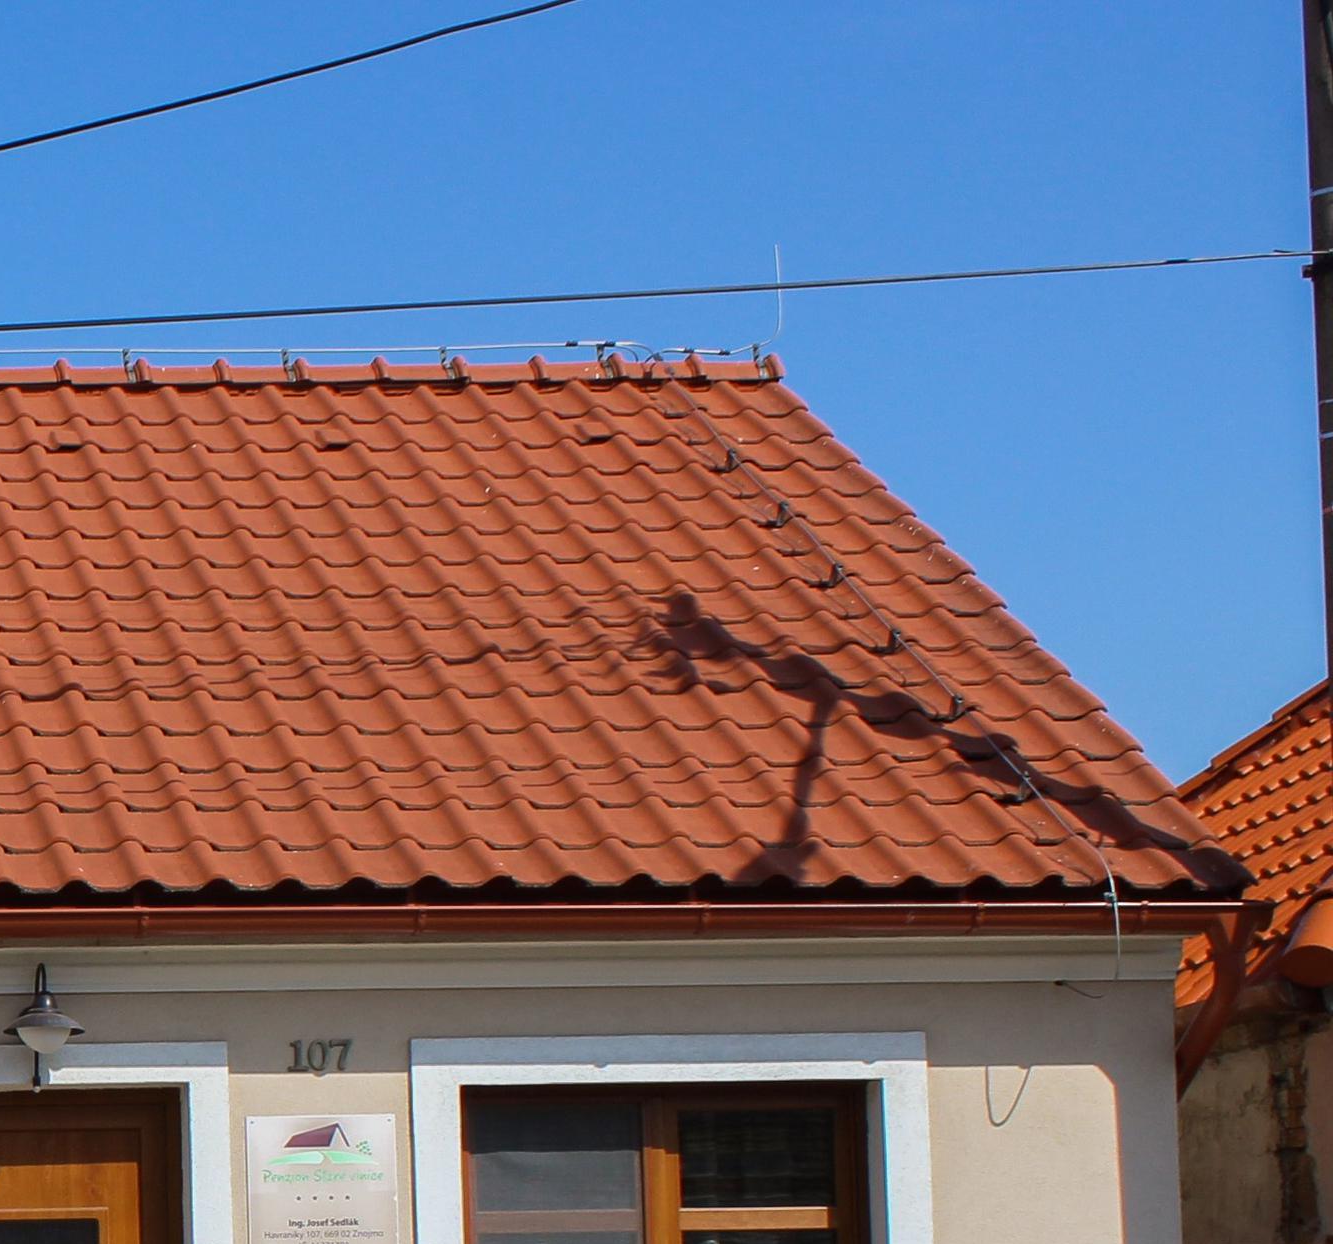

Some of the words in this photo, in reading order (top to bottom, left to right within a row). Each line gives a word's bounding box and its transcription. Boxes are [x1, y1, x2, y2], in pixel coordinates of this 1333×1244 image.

[287, 1038, 353, 1073] 107
[261, 1169, 309, 1183] Penzion
[288, 1219, 305, 1228] Ing.
[307, 1218, 329, 1227] Josef
[341, 1230, 350, 1238] 02
